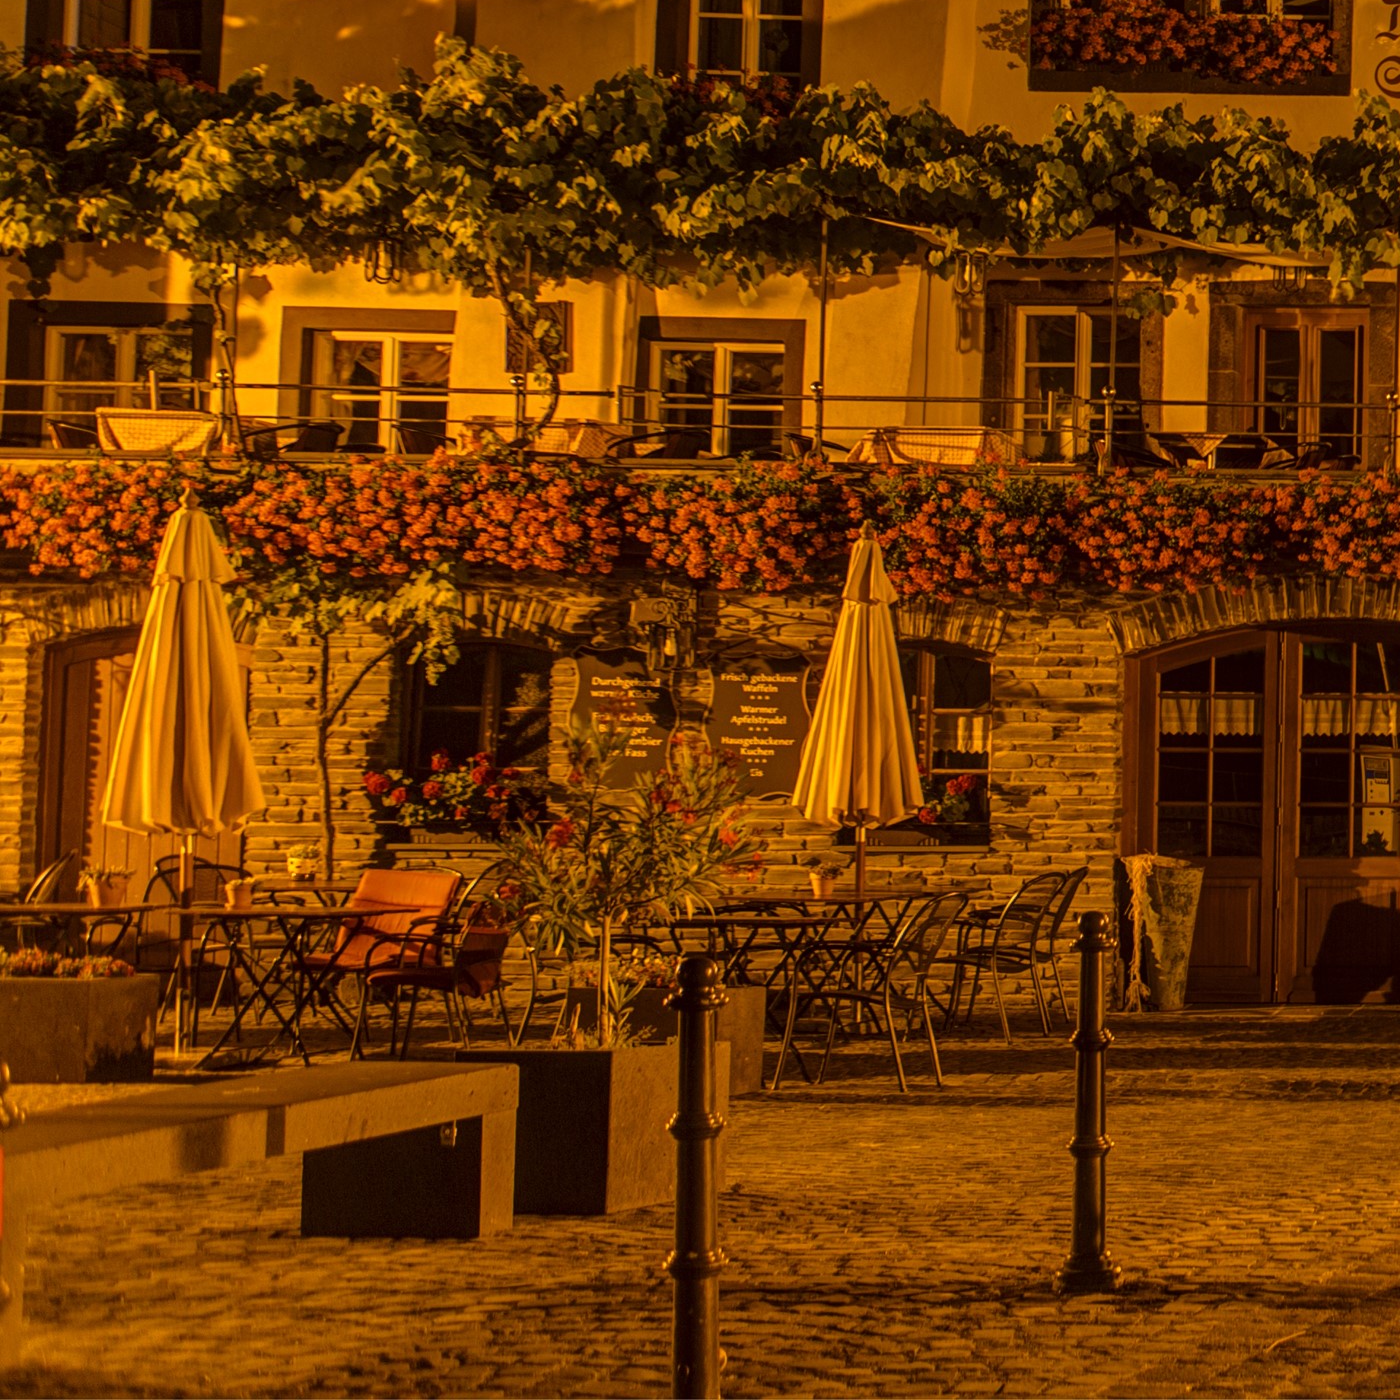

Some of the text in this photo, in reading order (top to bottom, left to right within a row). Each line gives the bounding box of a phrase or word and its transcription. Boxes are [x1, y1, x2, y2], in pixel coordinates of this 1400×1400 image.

[591, 676, 661, 690] Durchgehend
[720, 673, 798, 684] Frisch gebackene
[742, 684, 778, 693] Waffeln
[740, 705, 778, 714] Warmer
[730, 715, 787, 726] Apfelstrudel
[720, 736, 795, 747] Hausgebackener
[625, 748, 648, 758] Fass
[740, 747, 775, 756] Kuchen
